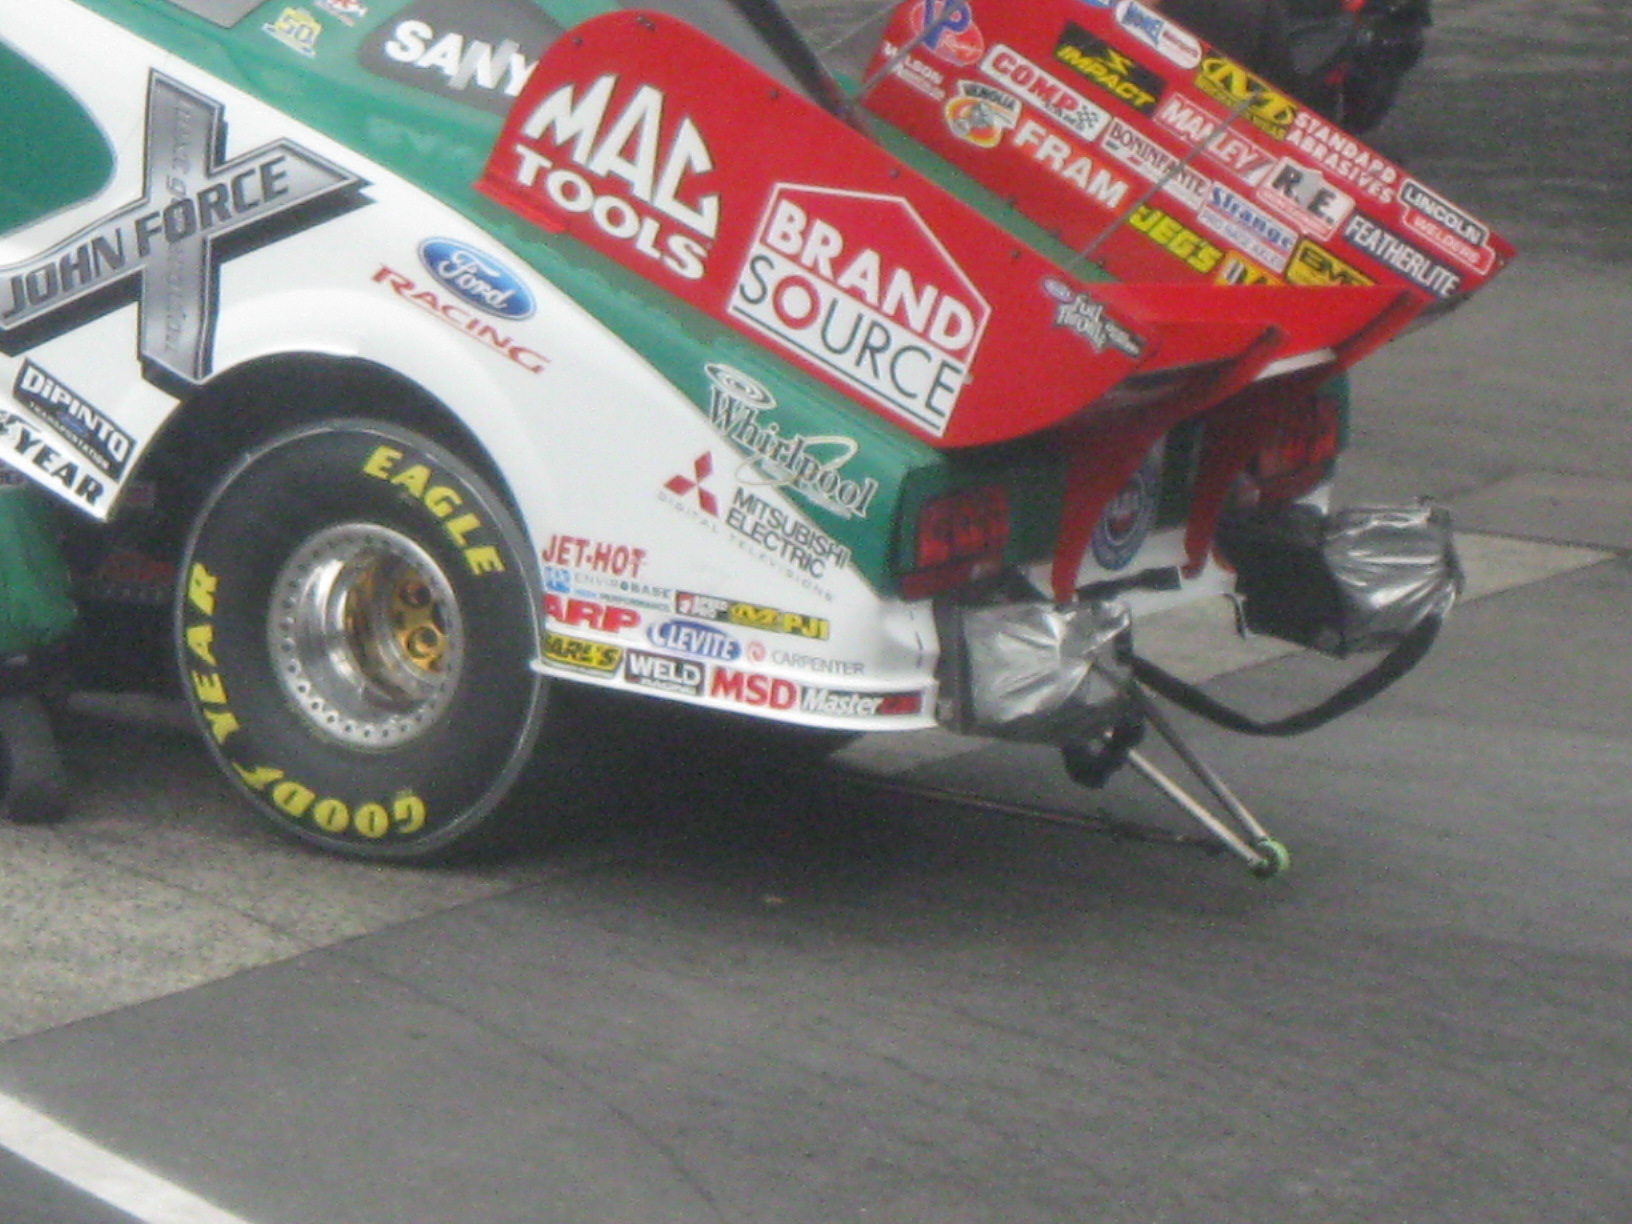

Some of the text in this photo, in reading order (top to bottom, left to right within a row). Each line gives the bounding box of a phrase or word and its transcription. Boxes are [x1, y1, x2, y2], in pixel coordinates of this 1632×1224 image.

[990, 52, 1081, 114] COMP
[1056, 43, 1157, 109] IMPACT
[521, 72, 722, 240] MAC
[1014, 119, 1130, 210] FRAM
[1159, 98, 1260, 171] MANLEY
[1286, 130, 1396, 206] ABRASIVES
[1294, 112, 1398, 186] STANDARD
[4, 155, 290, 319] JOHN FORCE
[513, 142, 709, 282] TOOLS
[1404, 182, 1485, 246] LINCOLN
[436, 248, 509, 312] Ford
[766, 199, 976, 354] BRAND
[1343, 214, 1461, 300] FEATHERLITE
[371, 263, 552, 375] RACING
[739, 254, 967, 420] SOURCE
[708, 386, 879, 519] Whirlpool
[362, 446, 505, 576] EAGLE
[725, 507, 826, 579] ELECTRIC
[732, 485, 852, 569] MITSUBISHI
[542, 592, 642, 634] ARP
[651, 621, 741, 662] CLEVITE
[628, 652, 702, 687] WELD
[710, 666, 797, 710] MSD
[771, 650, 865, 676] CARPENTER
